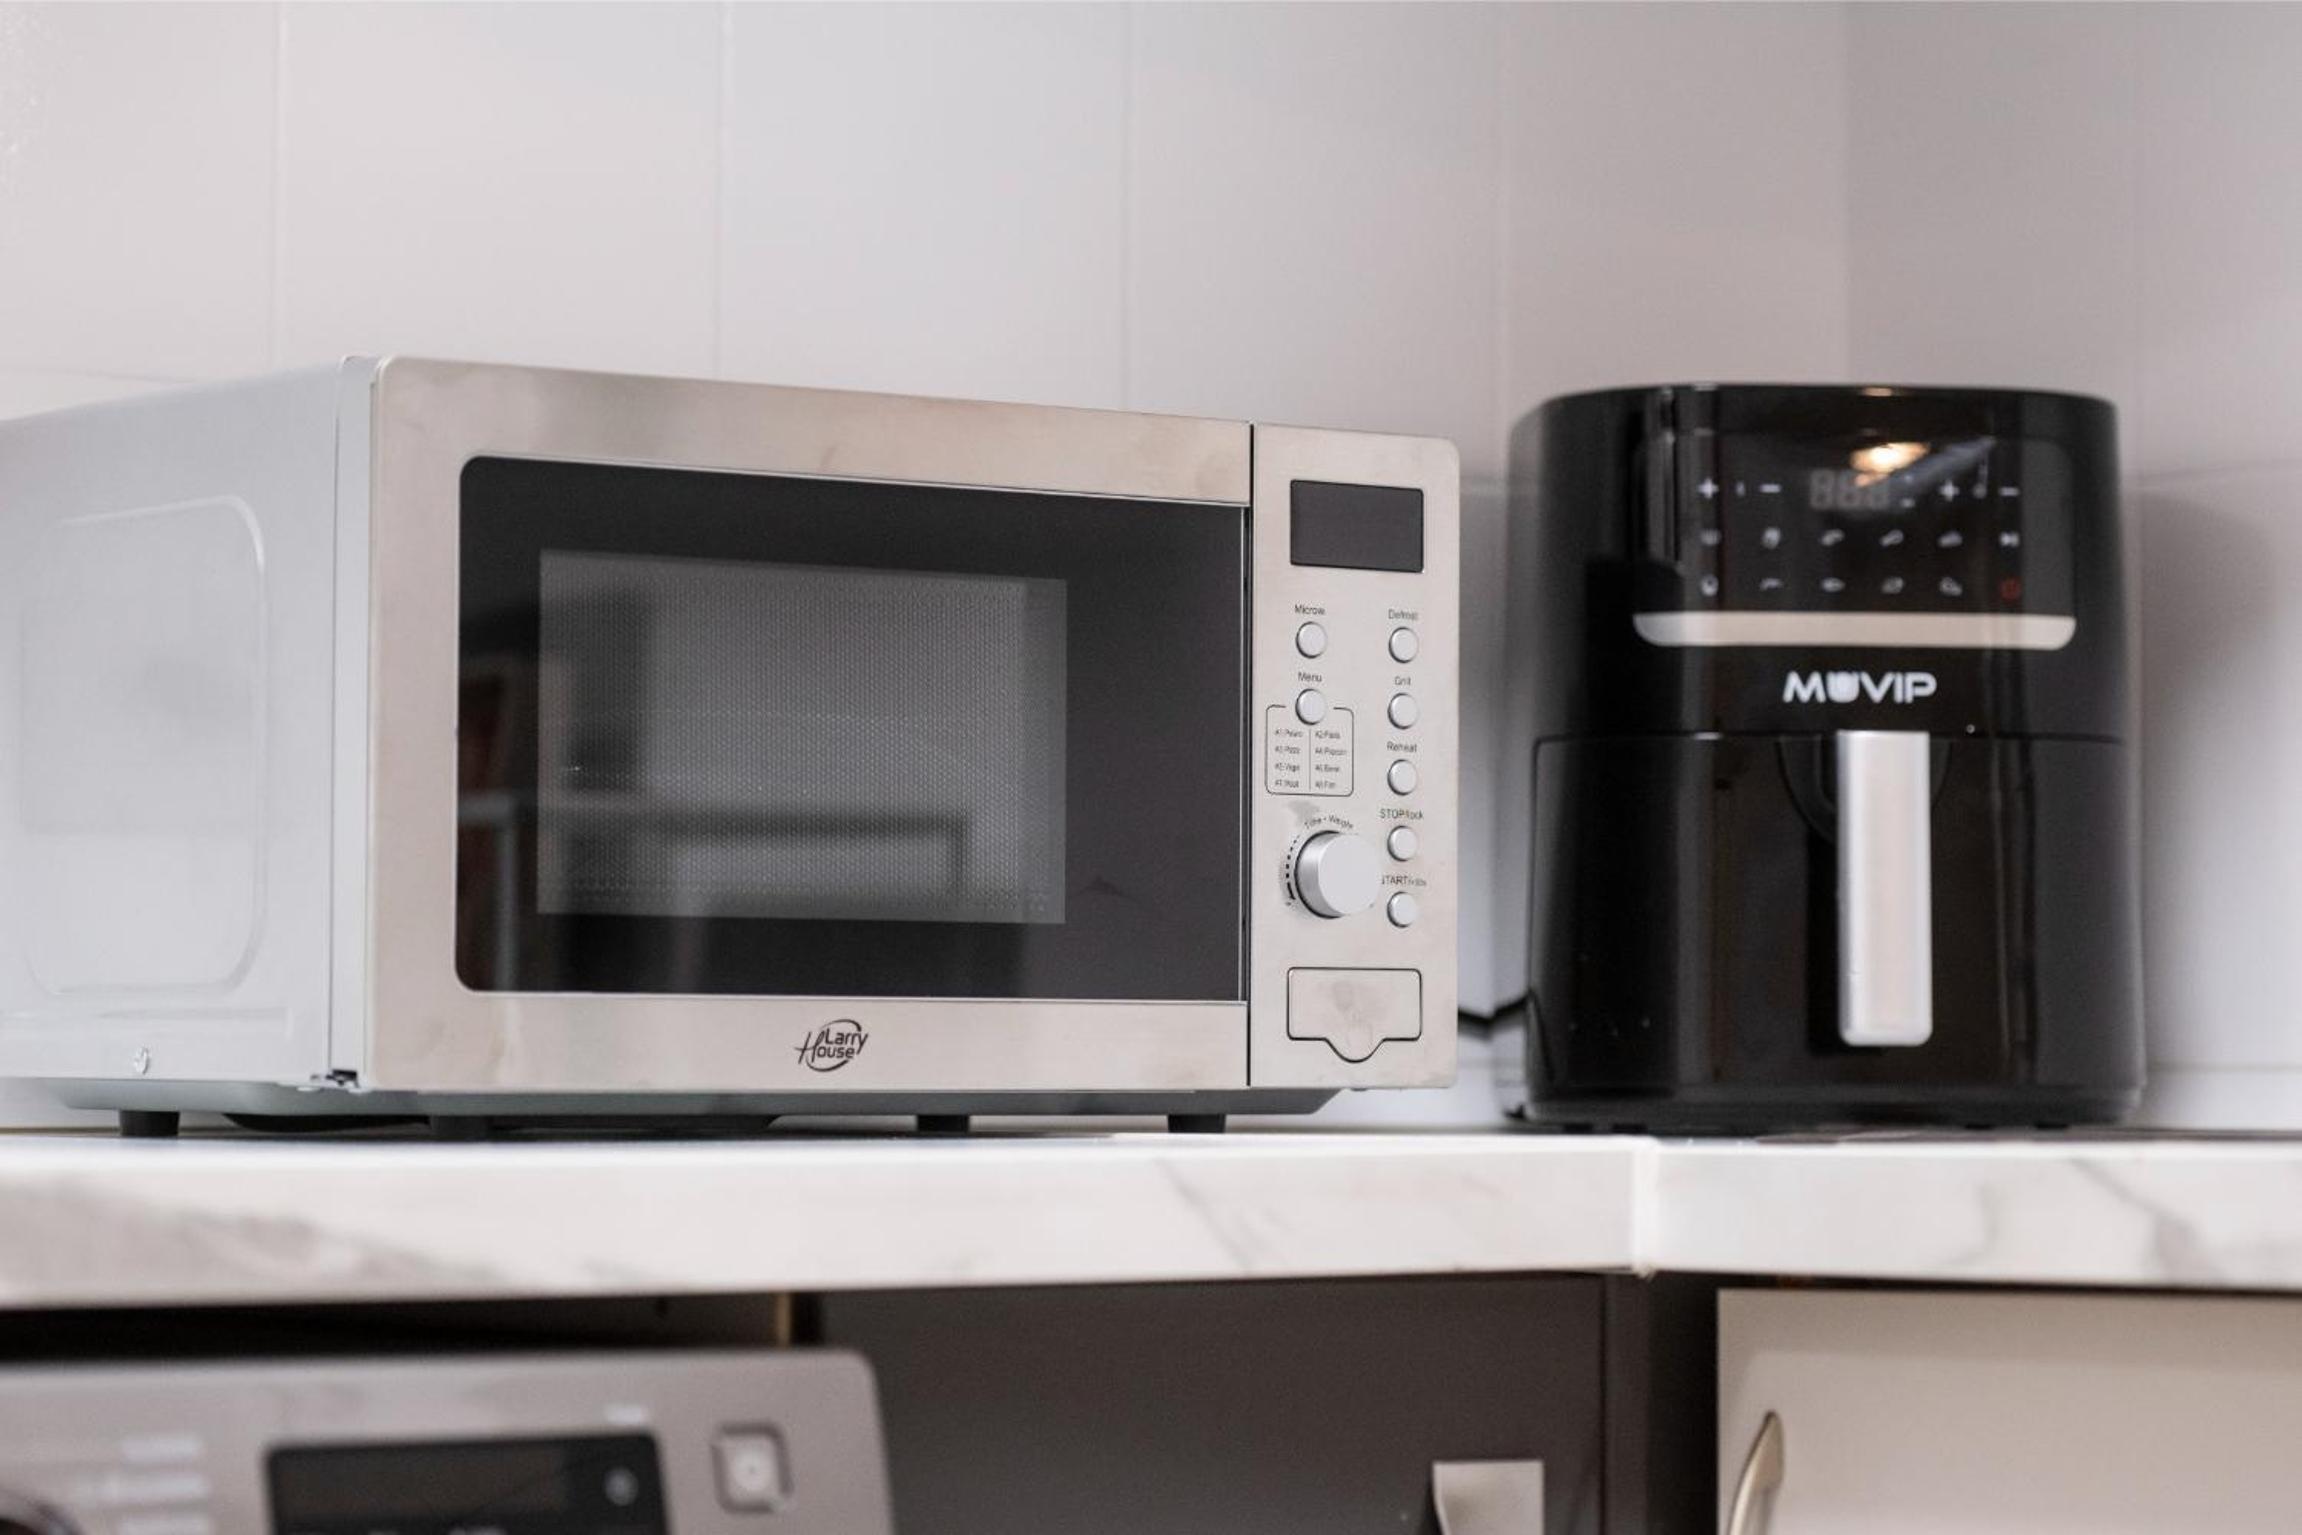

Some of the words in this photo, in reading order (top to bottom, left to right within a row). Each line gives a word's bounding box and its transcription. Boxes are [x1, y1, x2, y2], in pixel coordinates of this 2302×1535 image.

[1298, 671, 1322, 683] Menu
[795, 1030, 855, 1064] House
[824, 1028, 869, 1055] Larry
